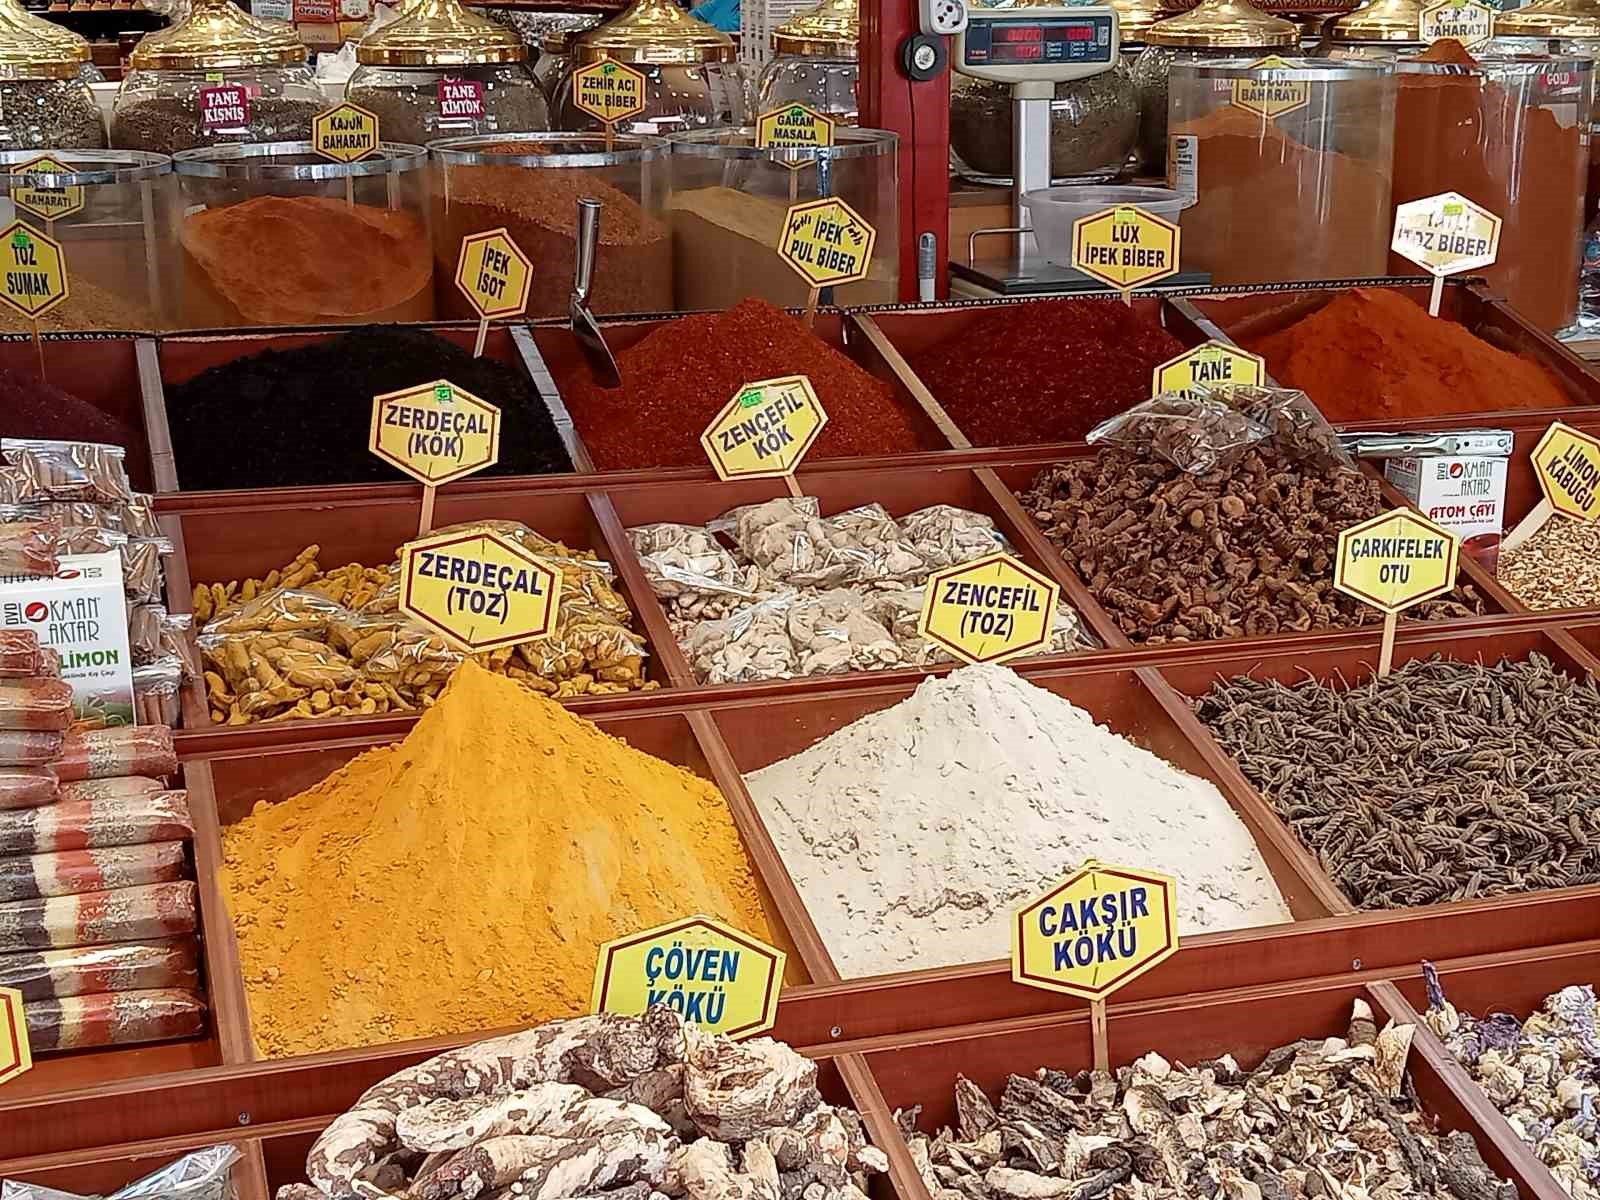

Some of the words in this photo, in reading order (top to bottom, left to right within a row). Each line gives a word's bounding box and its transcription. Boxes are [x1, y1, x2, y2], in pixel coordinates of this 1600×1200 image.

[443, 85, 476, 98] TANE
[582, 75, 615, 90] ZEHİR
[617, 79, 636, 92] ACI
[1241, 88, 1301, 101] BAHARATI
[206, 91, 241, 106] TANE
[441, 99, 481, 115] KİMYON
[581, 93, 602, 106] PUL
[604, 92, 637, 108] BİBER
[204, 105, 245, 124] KİŞNİŞ
[777, 115, 815, 127] GARAM
[322, 134, 371, 150] BAHARATI
[773, 128, 817, 141] MASALA
[24, 193, 72, 208] BAHARATI
[813, 214, 845, 245] İPEK
[1112, 221, 1140, 243] LÜX
[11, 243, 37, 266] TOZ
[1085, 241, 1118, 265] İPEK
[1121, 244, 1165, 268] BİBER
[1437, 231, 1487, 257] BİBER
[481, 240, 511, 276] İPEK
[790, 239, 813, 263] PUL
[816, 244, 856, 276] BİBER
[6, 272, 51, 296] SUMAK
[476, 266, 507, 300] İSOT
[1188, 357, 1232, 381] TANE
[385, 404, 489, 436] ZERDEÇAL
[407, 431, 464, 463] (KÖK)
[1563, 442, 1600, 491] LİMON
[1461, 479, 1491, 497] AKTAR
[1430, 505, 1465, 519] ATOM
[1469, 503, 1496, 520] ÇAYI
[1351, 538, 1445, 563] ÇARKIFELEK
[418, 552, 544, 596] ZERDEÇAL
[1379, 564, 1410, 584] OTU
[447, 586, 509, 625] (TOZ)
[942, 581, 1040, 612] ZENCEFİL
[48, 620, 100, 645] AKTAR
[960, 610, 1014, 643] (TOZ)
[59, 649, 119, 669] LİMON
[1038, 887, 1150, 934] CAKŞIR
[1053, 920, 1137, 972] KÖKÜ
[645, 941, 740, 987] ÇÖVEN
